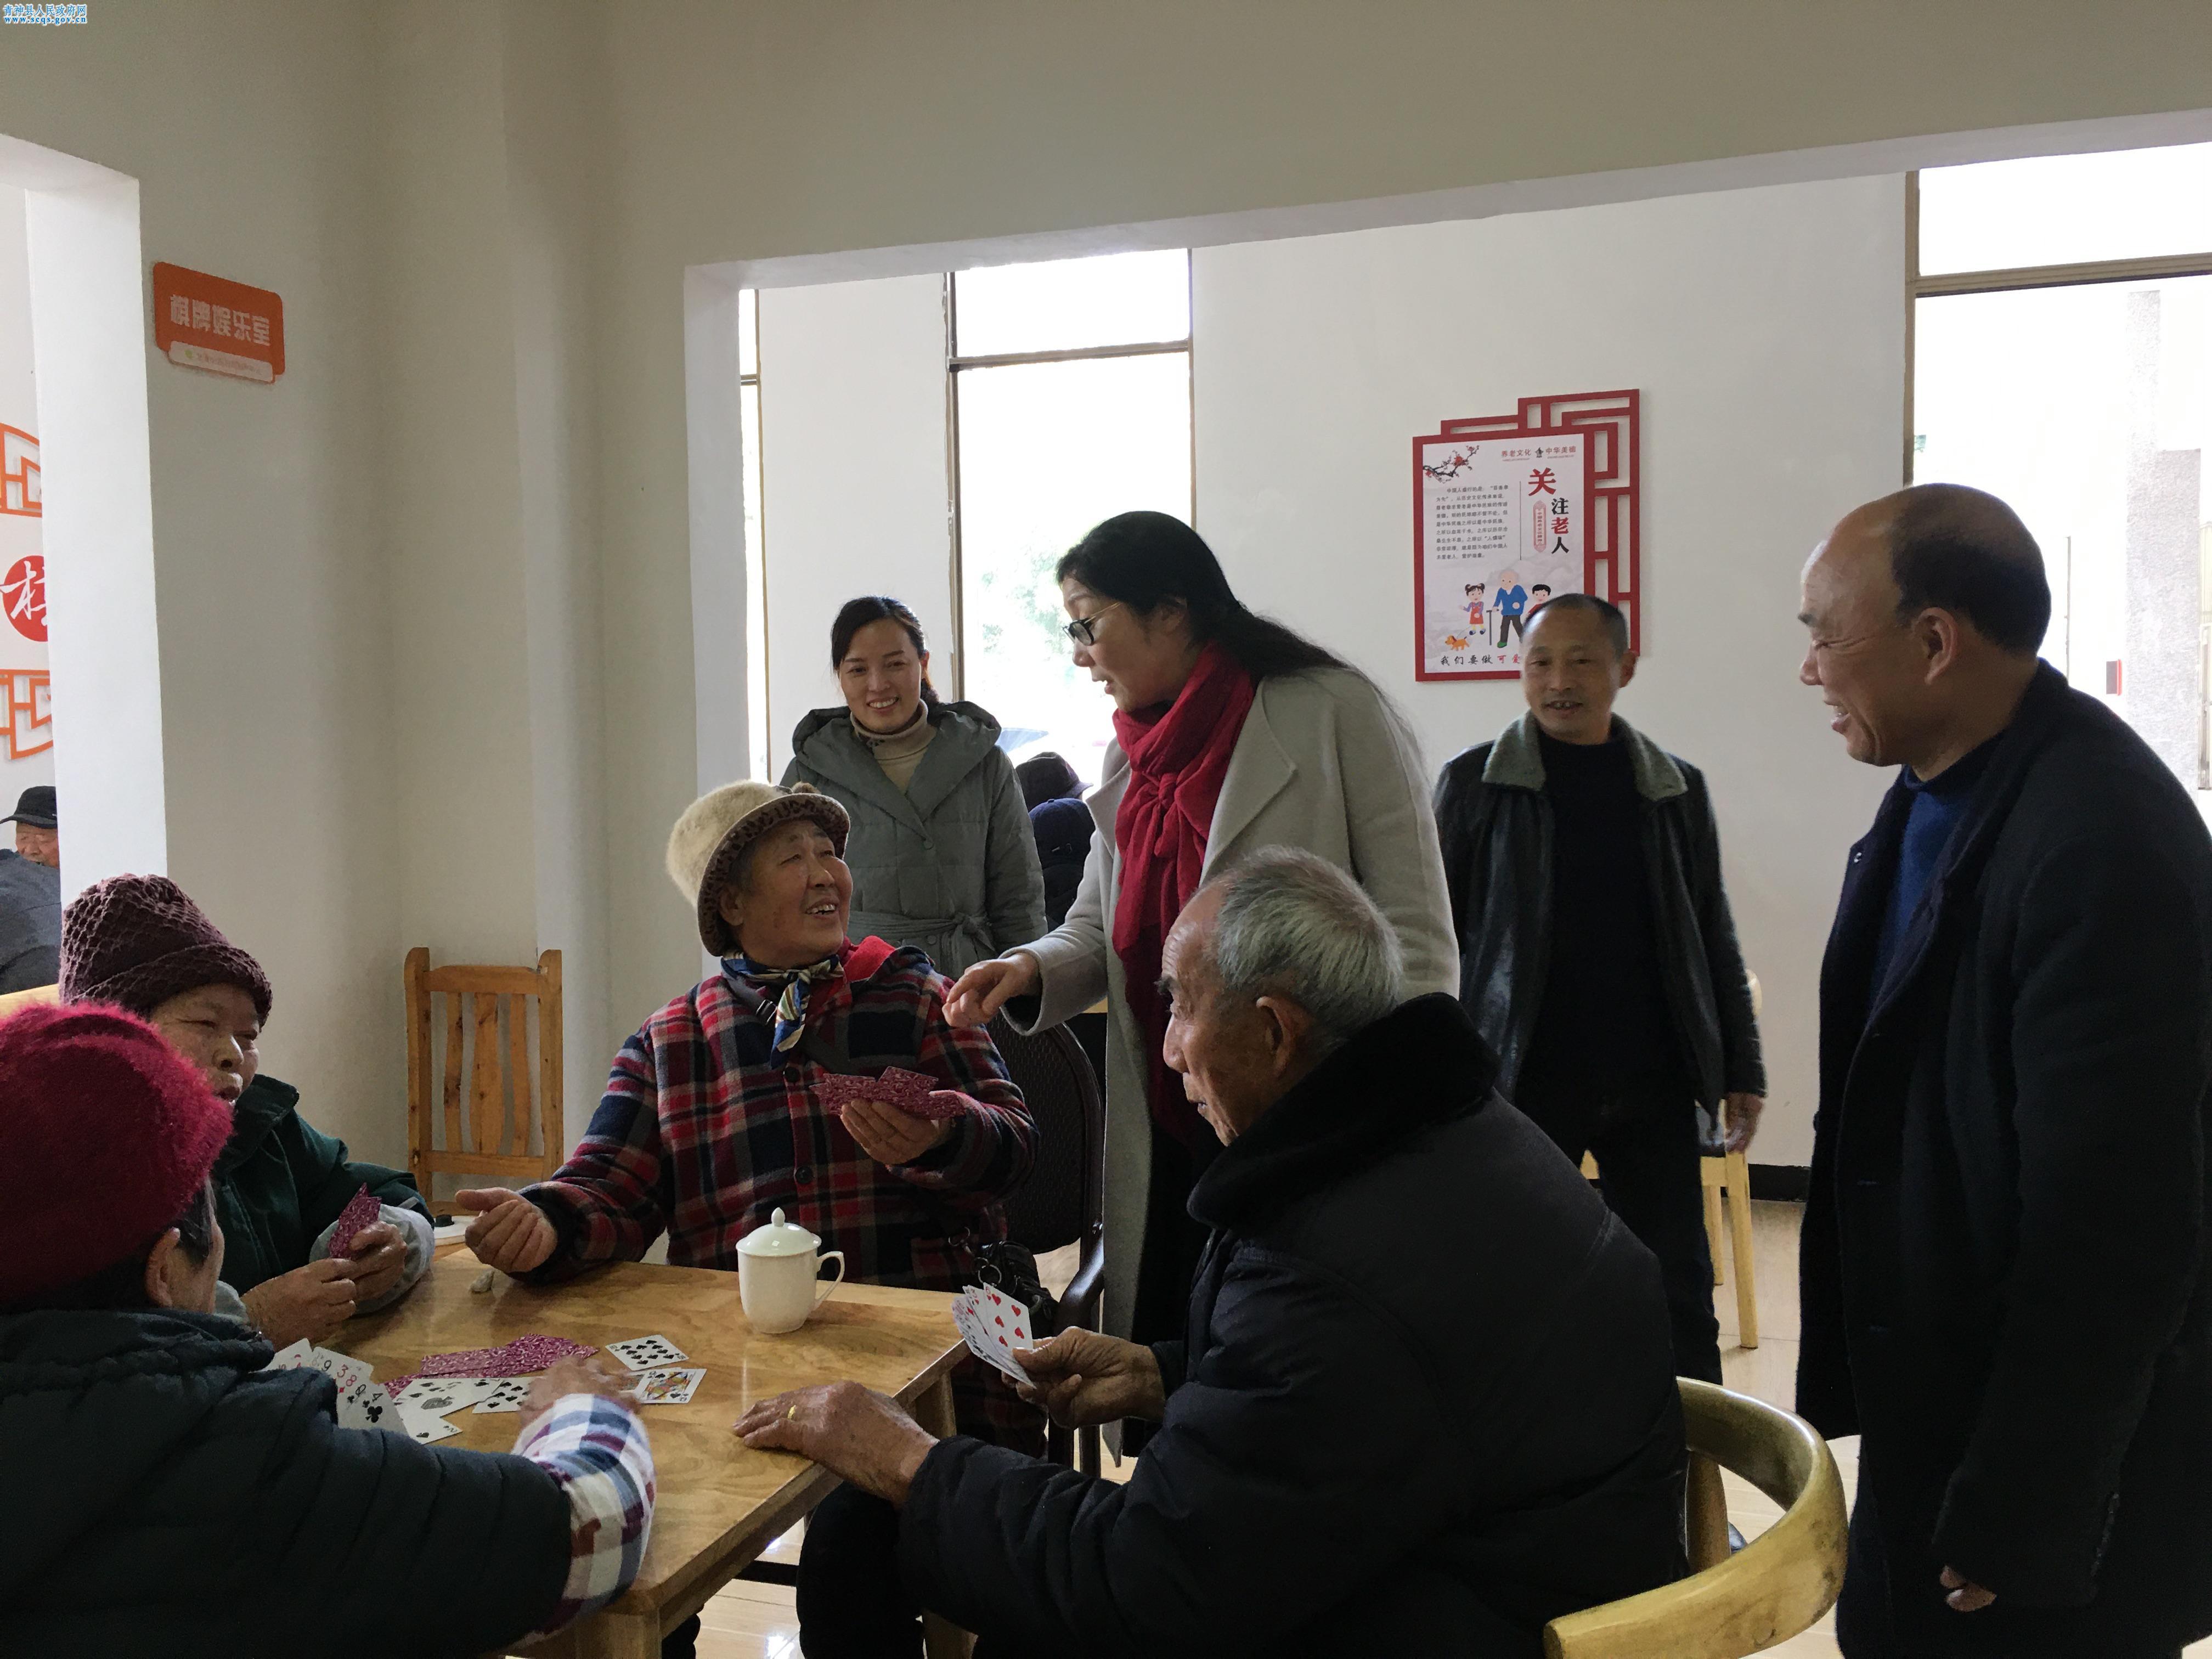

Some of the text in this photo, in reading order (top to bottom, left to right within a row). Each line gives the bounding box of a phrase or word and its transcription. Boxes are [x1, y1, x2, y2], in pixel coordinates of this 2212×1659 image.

[170, 294, 270, 346] 棋牌娱乐室
[1546, 445, 1576, 454] 中华美德
[1528, 467, 1556, 496] 关
[1551, 497, 1569, 554] 注老人
[1440, 653, 1520, 667] 我们要做可爱
[985, 1286, 991, 1295] 6
[321, 1359, 332, 1372] 9
[337, 1364, 349, 1378] 3
[346, 1374, 357, 1387] 8
[372, 1392, 383, 1403] 4
